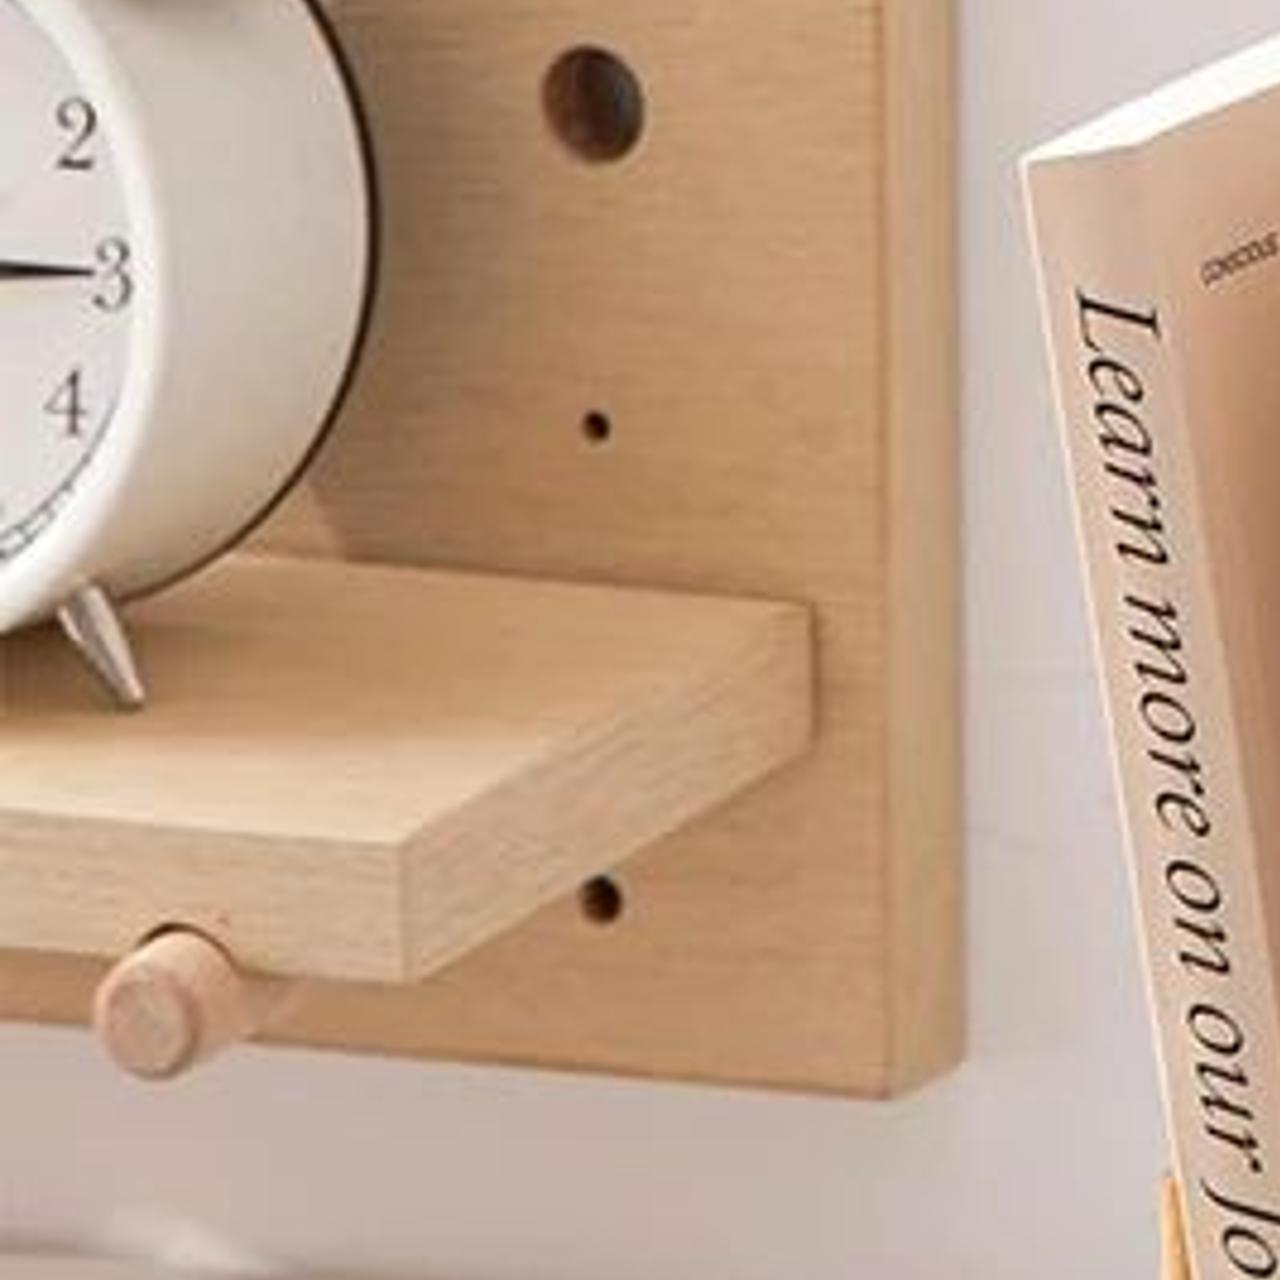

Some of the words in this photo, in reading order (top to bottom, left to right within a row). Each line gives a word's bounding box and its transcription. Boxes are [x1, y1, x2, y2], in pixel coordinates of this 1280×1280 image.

[55, 96, 97, 171] 2
[92, 235, 133, 310] 3
[43, 367, 87, 436] 4
[1076, 288, 1168, 563] Learn
[1123, 594, 1211, 837] more
[1165, 859, 1231, 977] on
[1185, 1002, 1264, 1175] our
